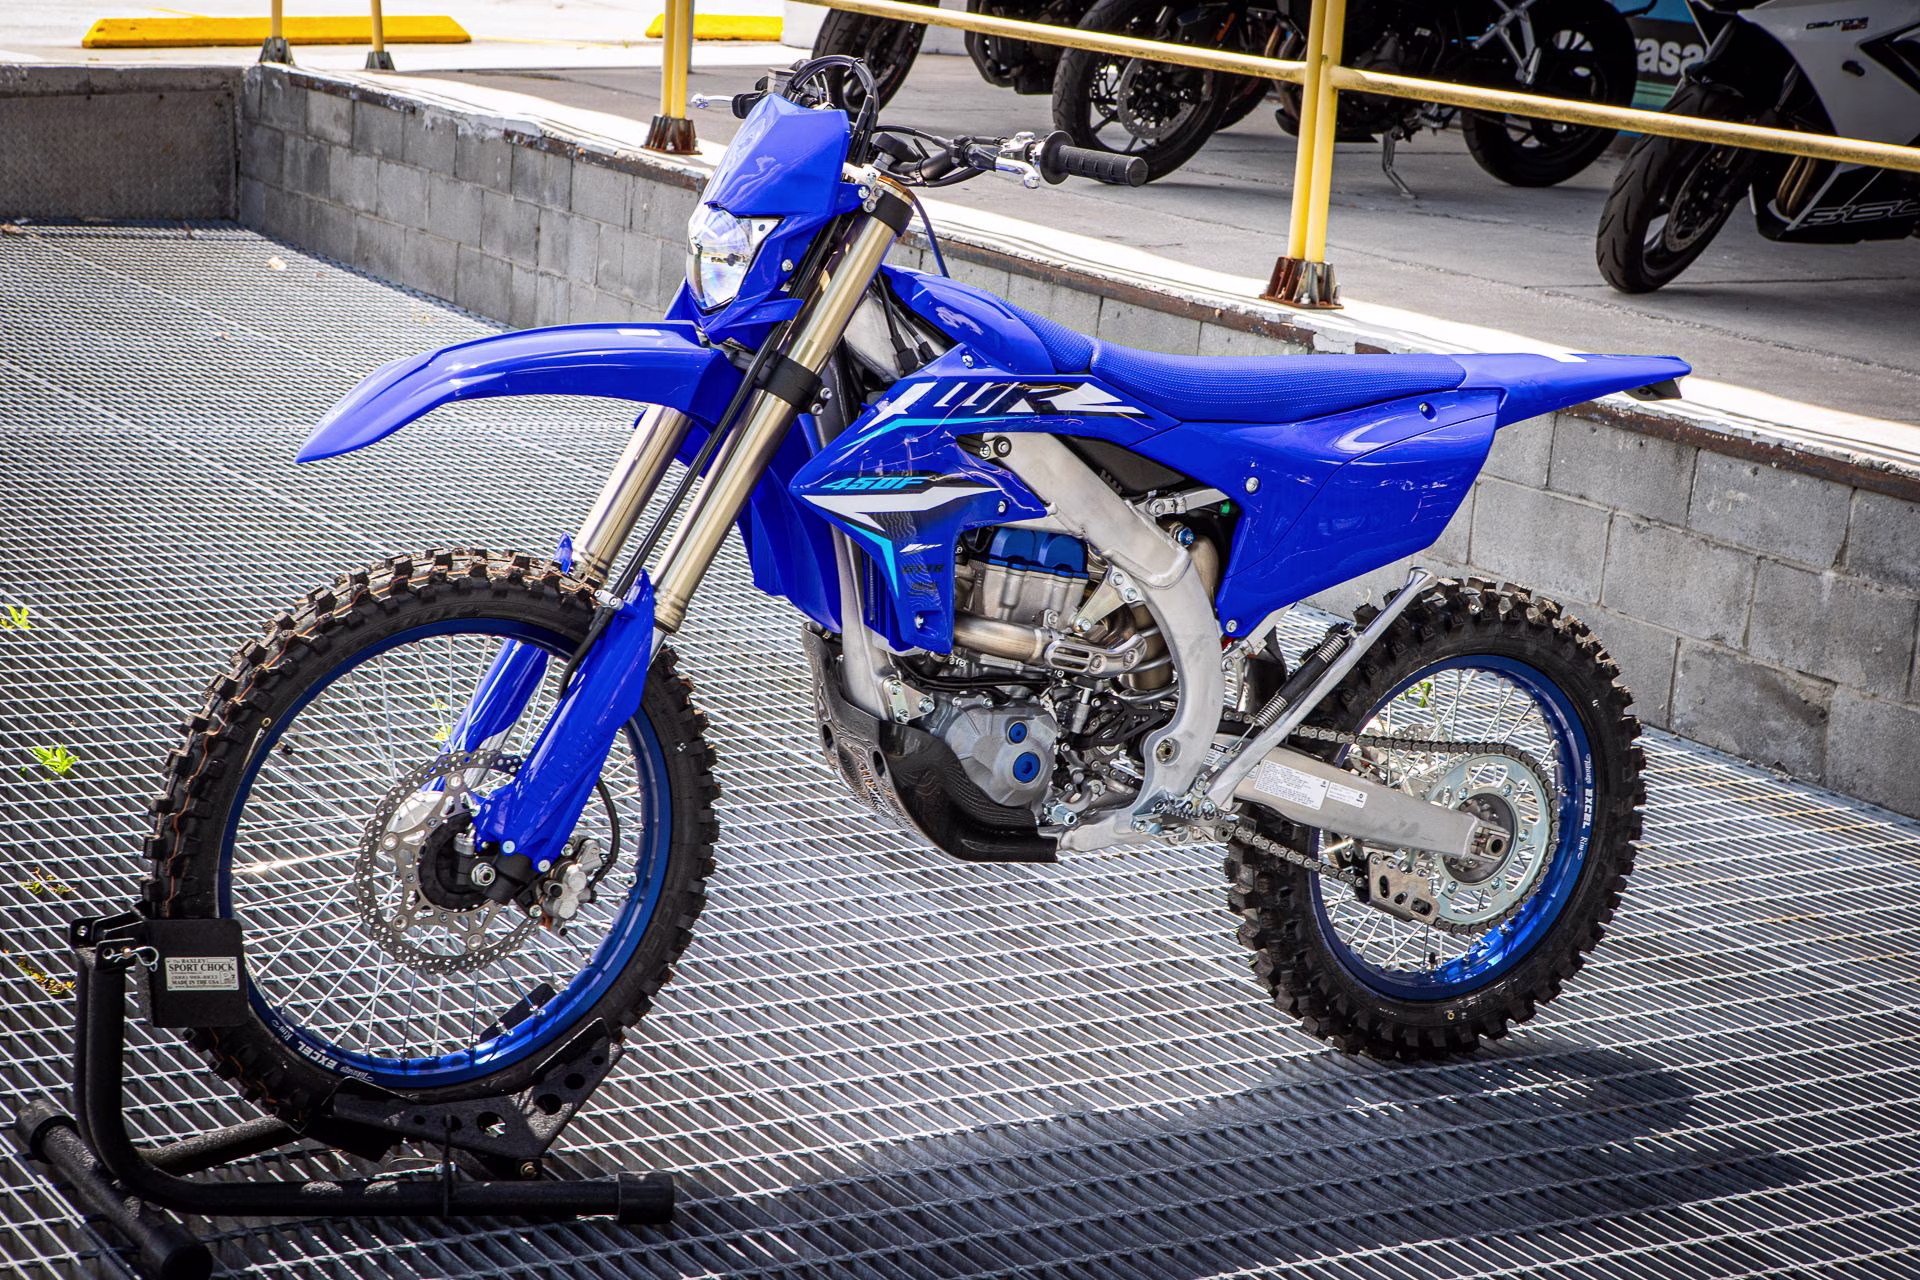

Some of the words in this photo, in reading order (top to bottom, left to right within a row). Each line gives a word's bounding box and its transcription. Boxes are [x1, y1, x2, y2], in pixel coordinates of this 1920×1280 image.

[1634, 37, 1705, 77] asa
[820, 477, 930, 490] 450F
[1582, 788, 1593, 829] EXCEL
[168, 963, 199, 971] SPORT
[200, 963, 235, 971] CHOCK
[297, 1040, 338, 1070] EXCEL
